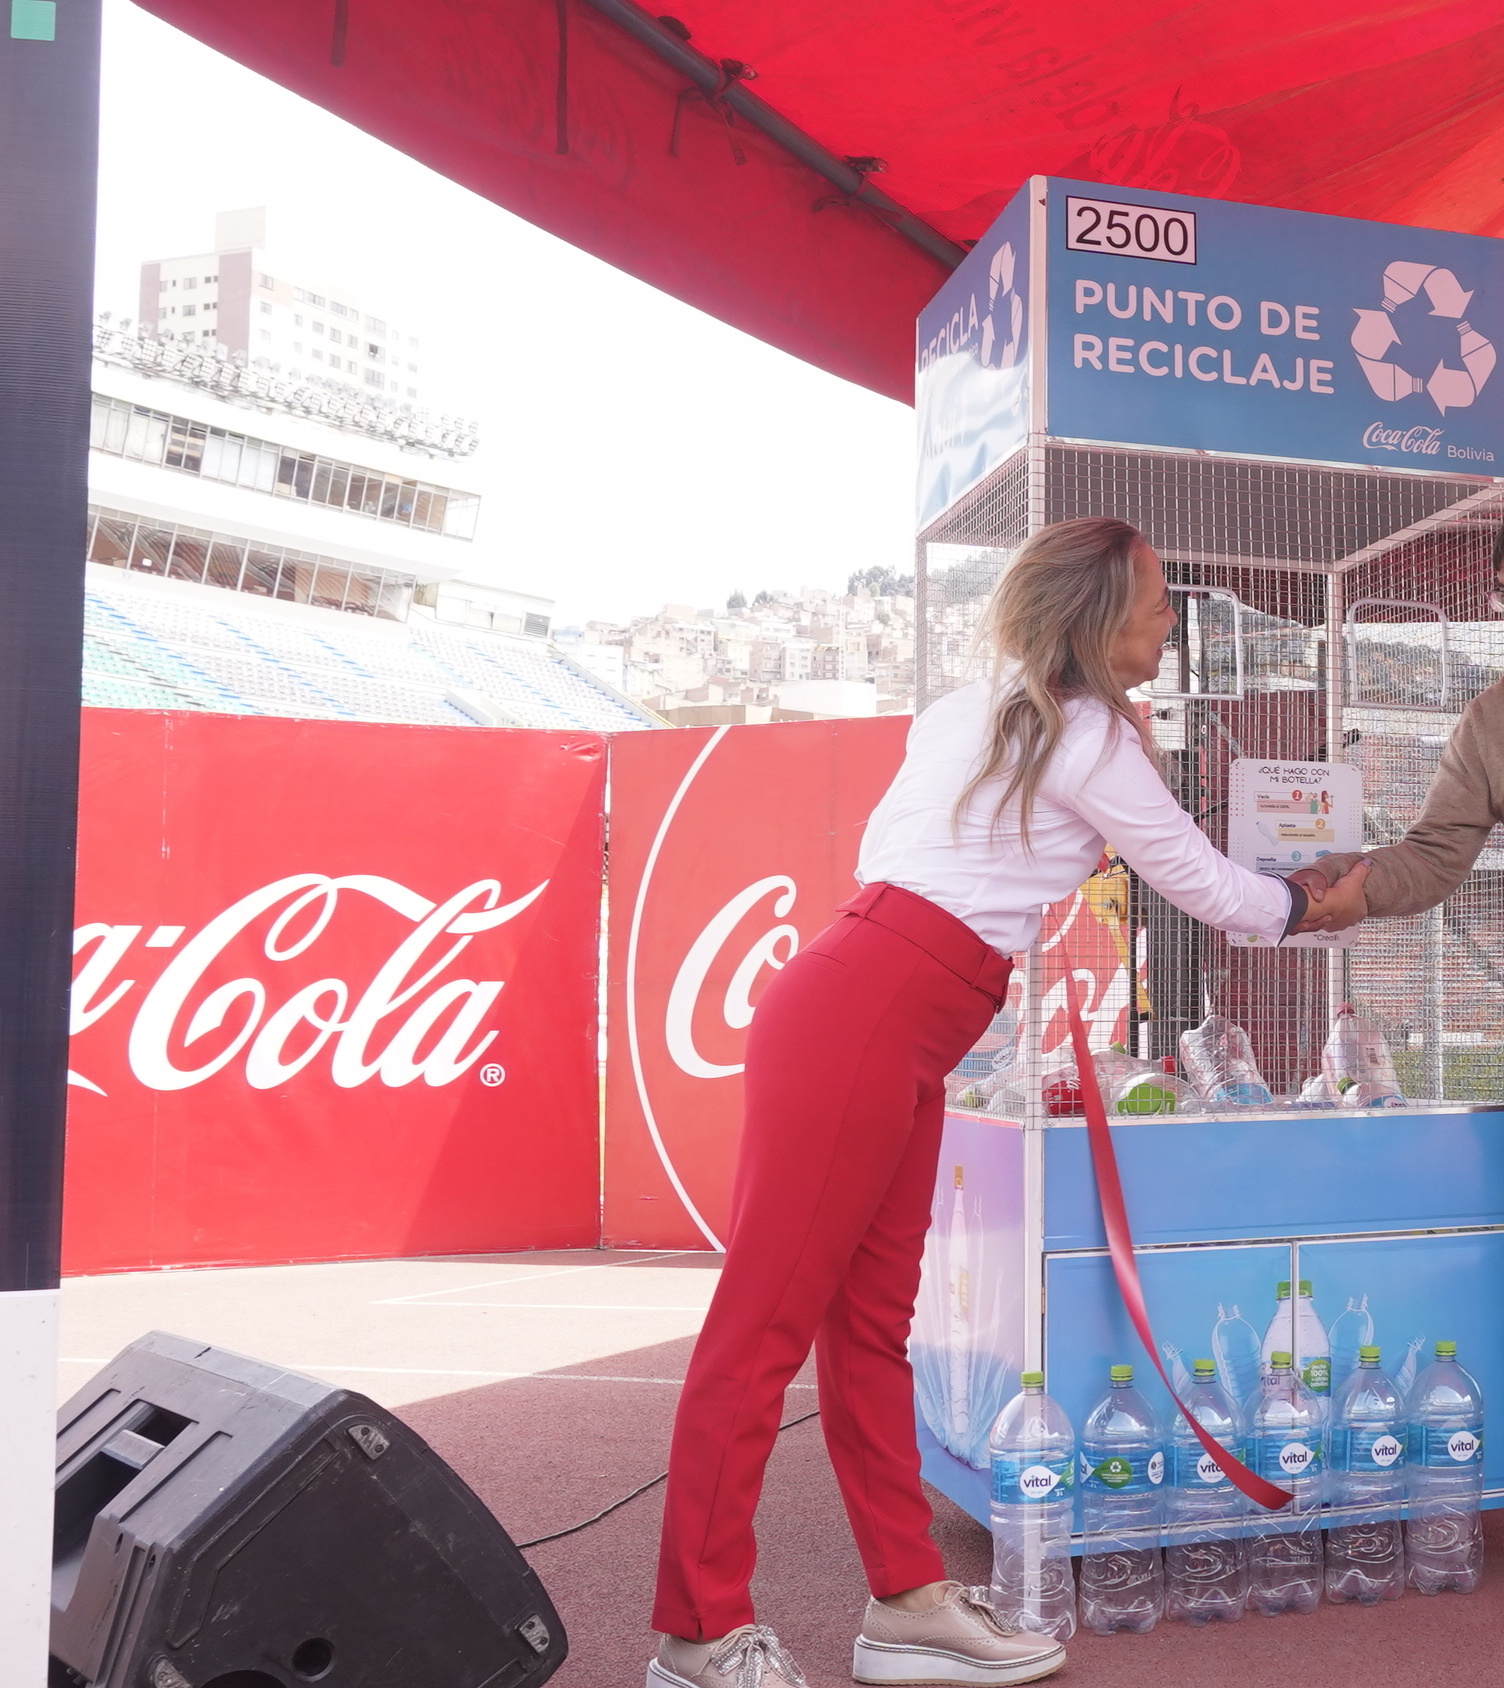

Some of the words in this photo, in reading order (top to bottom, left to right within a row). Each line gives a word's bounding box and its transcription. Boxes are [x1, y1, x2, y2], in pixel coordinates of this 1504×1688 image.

[1075, 205, 1189, 257] 2500
[1074, 279, 1243, 331] PUNTO
[1260, 300, 1321, 340] DE
[1073, 333, 1335, 395] RECICLAJE
[1362, 421, 1445, 456] Coca-Cola
[1447, 444, 1496, 462] Bolivia
[1283, 767, 1308, 776] HAGO
[1310, 768, 1330, 777] CON
[1374, 1444, 1397, 1457] vital
[1450, 1439, 1474, 1453] vital
[1282, 1450, 1308, 1464] vital
[1200, 1460, 1222, 1474] vita
[1023, 1474, 1052, 1488] vital
